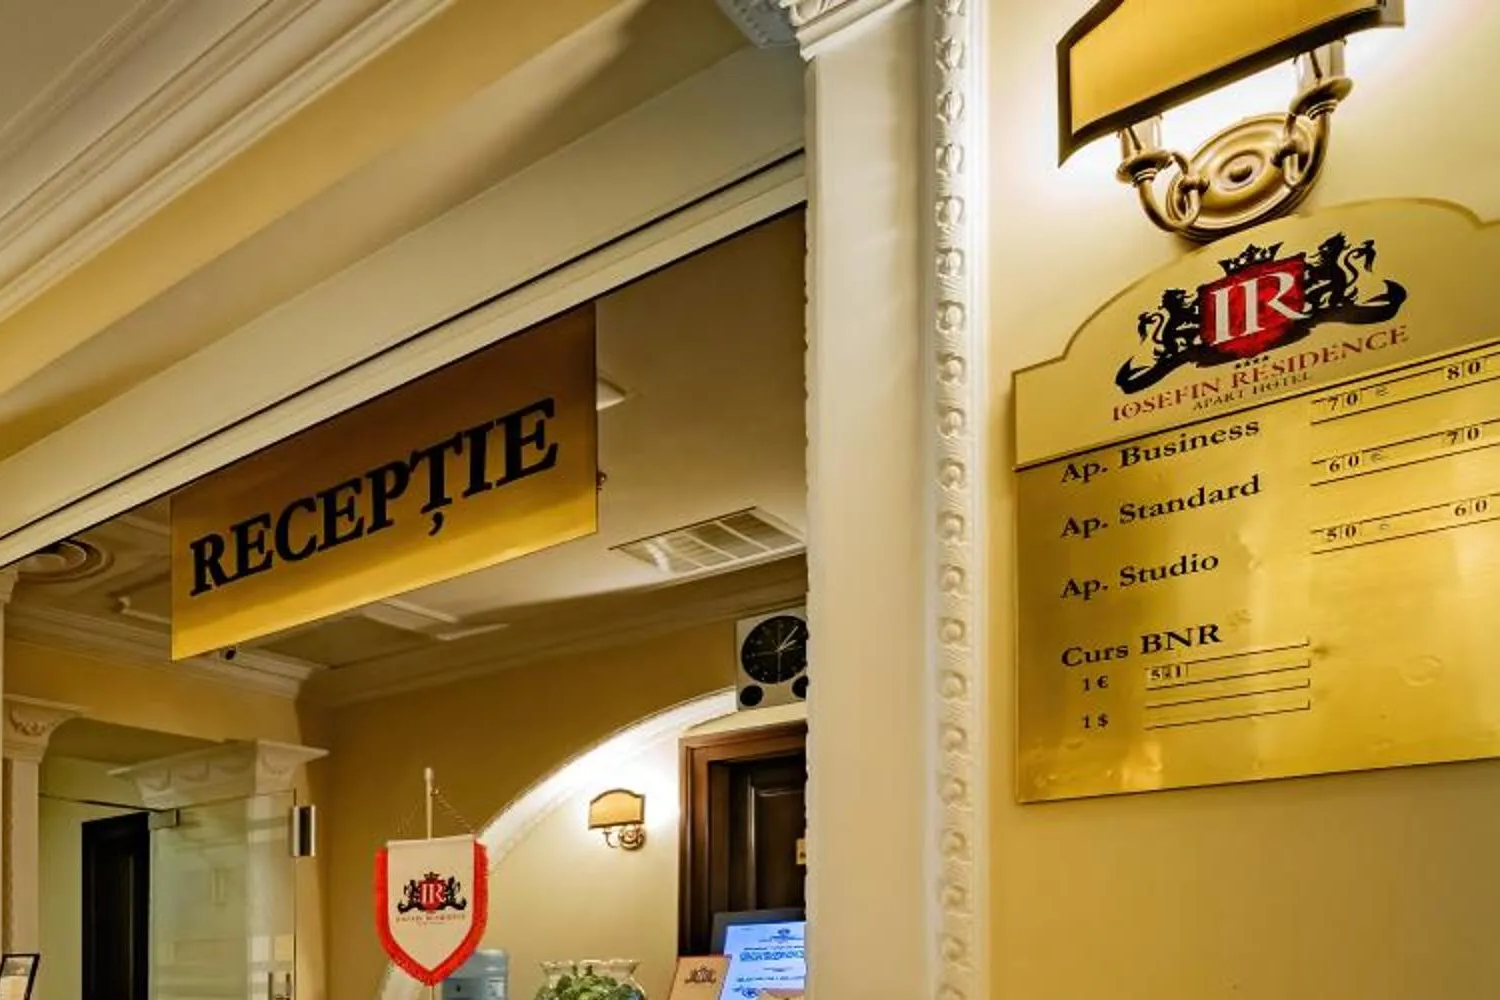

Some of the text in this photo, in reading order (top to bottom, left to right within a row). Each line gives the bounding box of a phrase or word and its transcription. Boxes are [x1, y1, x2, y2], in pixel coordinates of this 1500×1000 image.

[1209, 271, 1310, 344] IR
[1113, 325, 1411, 421] IOSEFIN RESIDENCE
[1192, 372, 1311, 411] APART HOTEL
[1060, 461, 1108, 485] Ap.
[1119, 418, 1261, 467] Business
[1328, 391, 1359, 410] 70
[1447, 361, 1481, 380] 80
[1060, 516, 1108, 540] Ap.
[1119, 474, 1261, 525] Standard
[1329, 455, 1360, 473] 60
[1447, 427, 1479, 444] 70
[1060, 576, 1108, 600] Ap.
[1119, 552, 1220, 589] Studio
[1454, 499, 1488, 517] 60
[1061, 623, 1223, 667] Curs BNR
